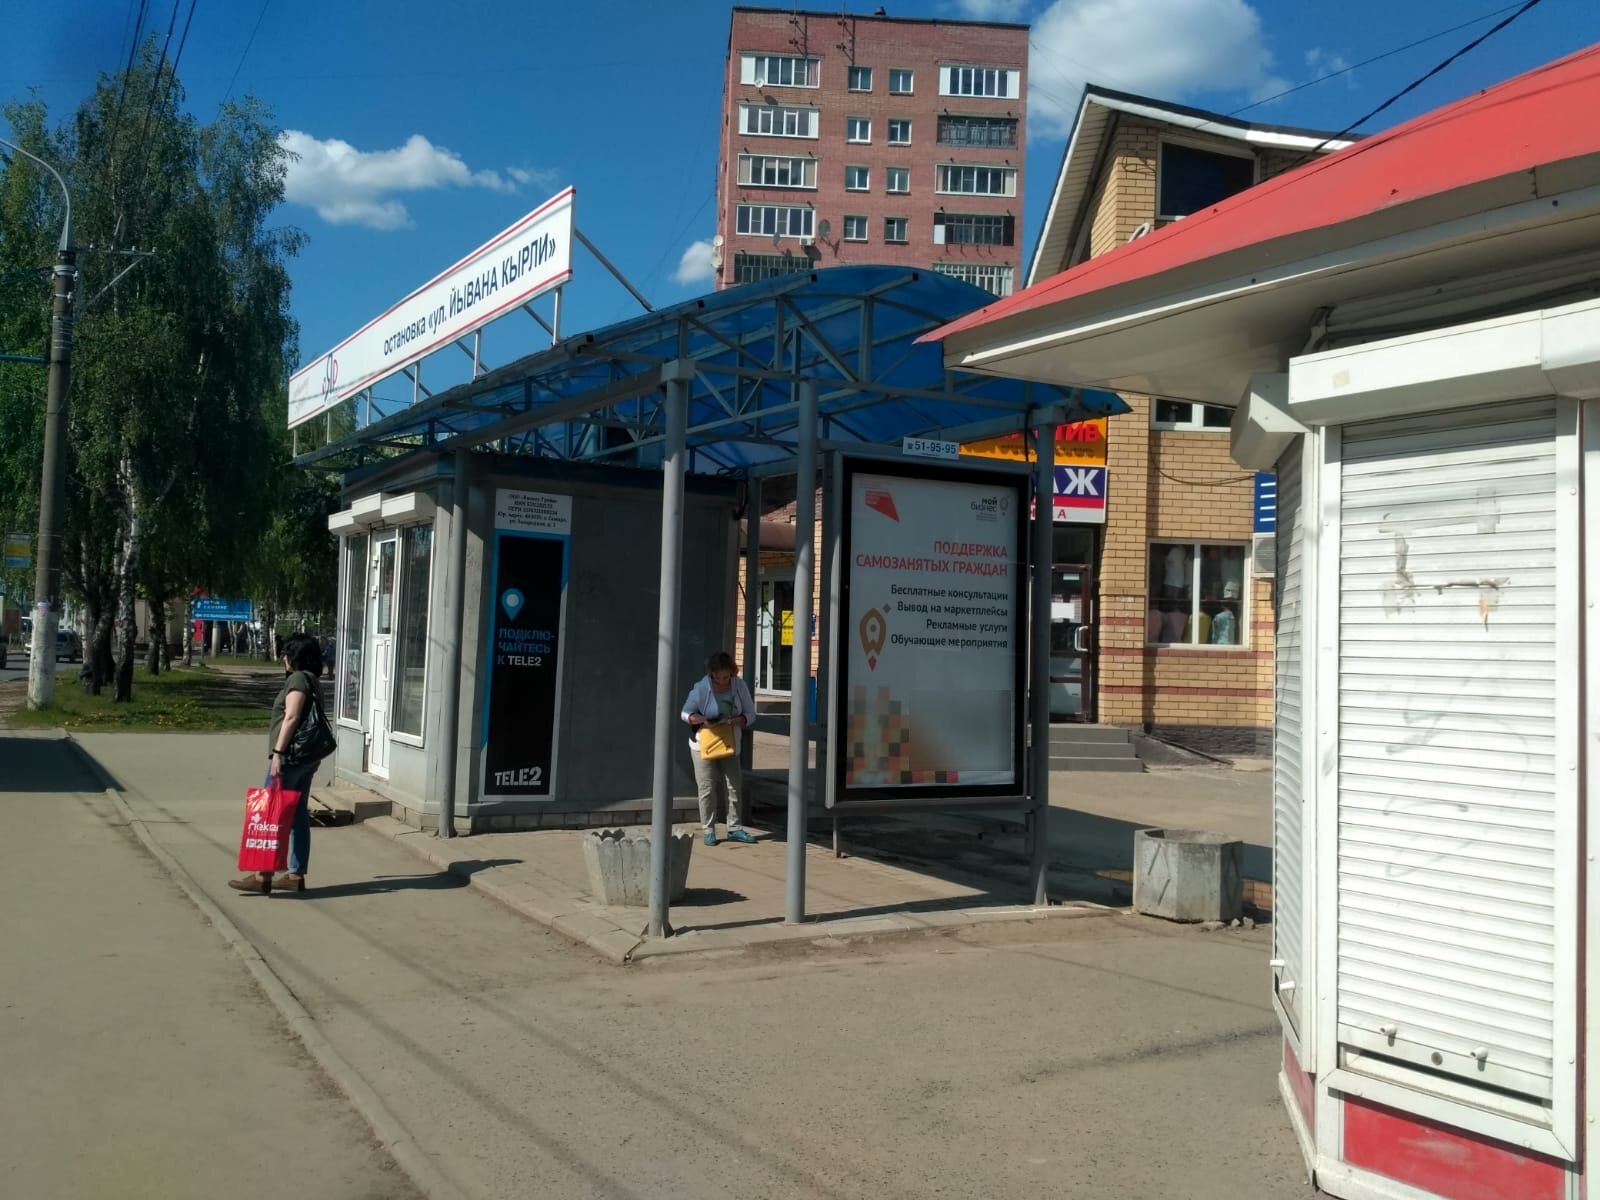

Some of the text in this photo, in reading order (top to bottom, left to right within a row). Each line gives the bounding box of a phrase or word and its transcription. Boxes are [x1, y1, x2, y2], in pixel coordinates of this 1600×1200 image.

[383, 232, 556, 356] остановка «ул. ЙЫВАНА КЫРЛИ»
[914, 440, 956, 454] 51-95-95
[933, 541, 1008, 558] ПОДДЕРЖКА
[856, 554, 1008, 576] САМОЗАНЯТЫХ ГРАЖДАН
[891, 584, 1008, 601] Бесплатные консультации
[897, 601, 1008, 617] Вывод на маркетплейсы
[926, 619, 1008, 634] Рекламные услуги
[498, 628, 556, 641] ПОДКЛЮ-
[890, 634, 1008, 649] Обучающие мероприятия
[497, 640, 551, 653] ЧАЙТЕСЬ
[507, 655, 542, 667] TELE2
[494, 766, 542, 786] TELE2
